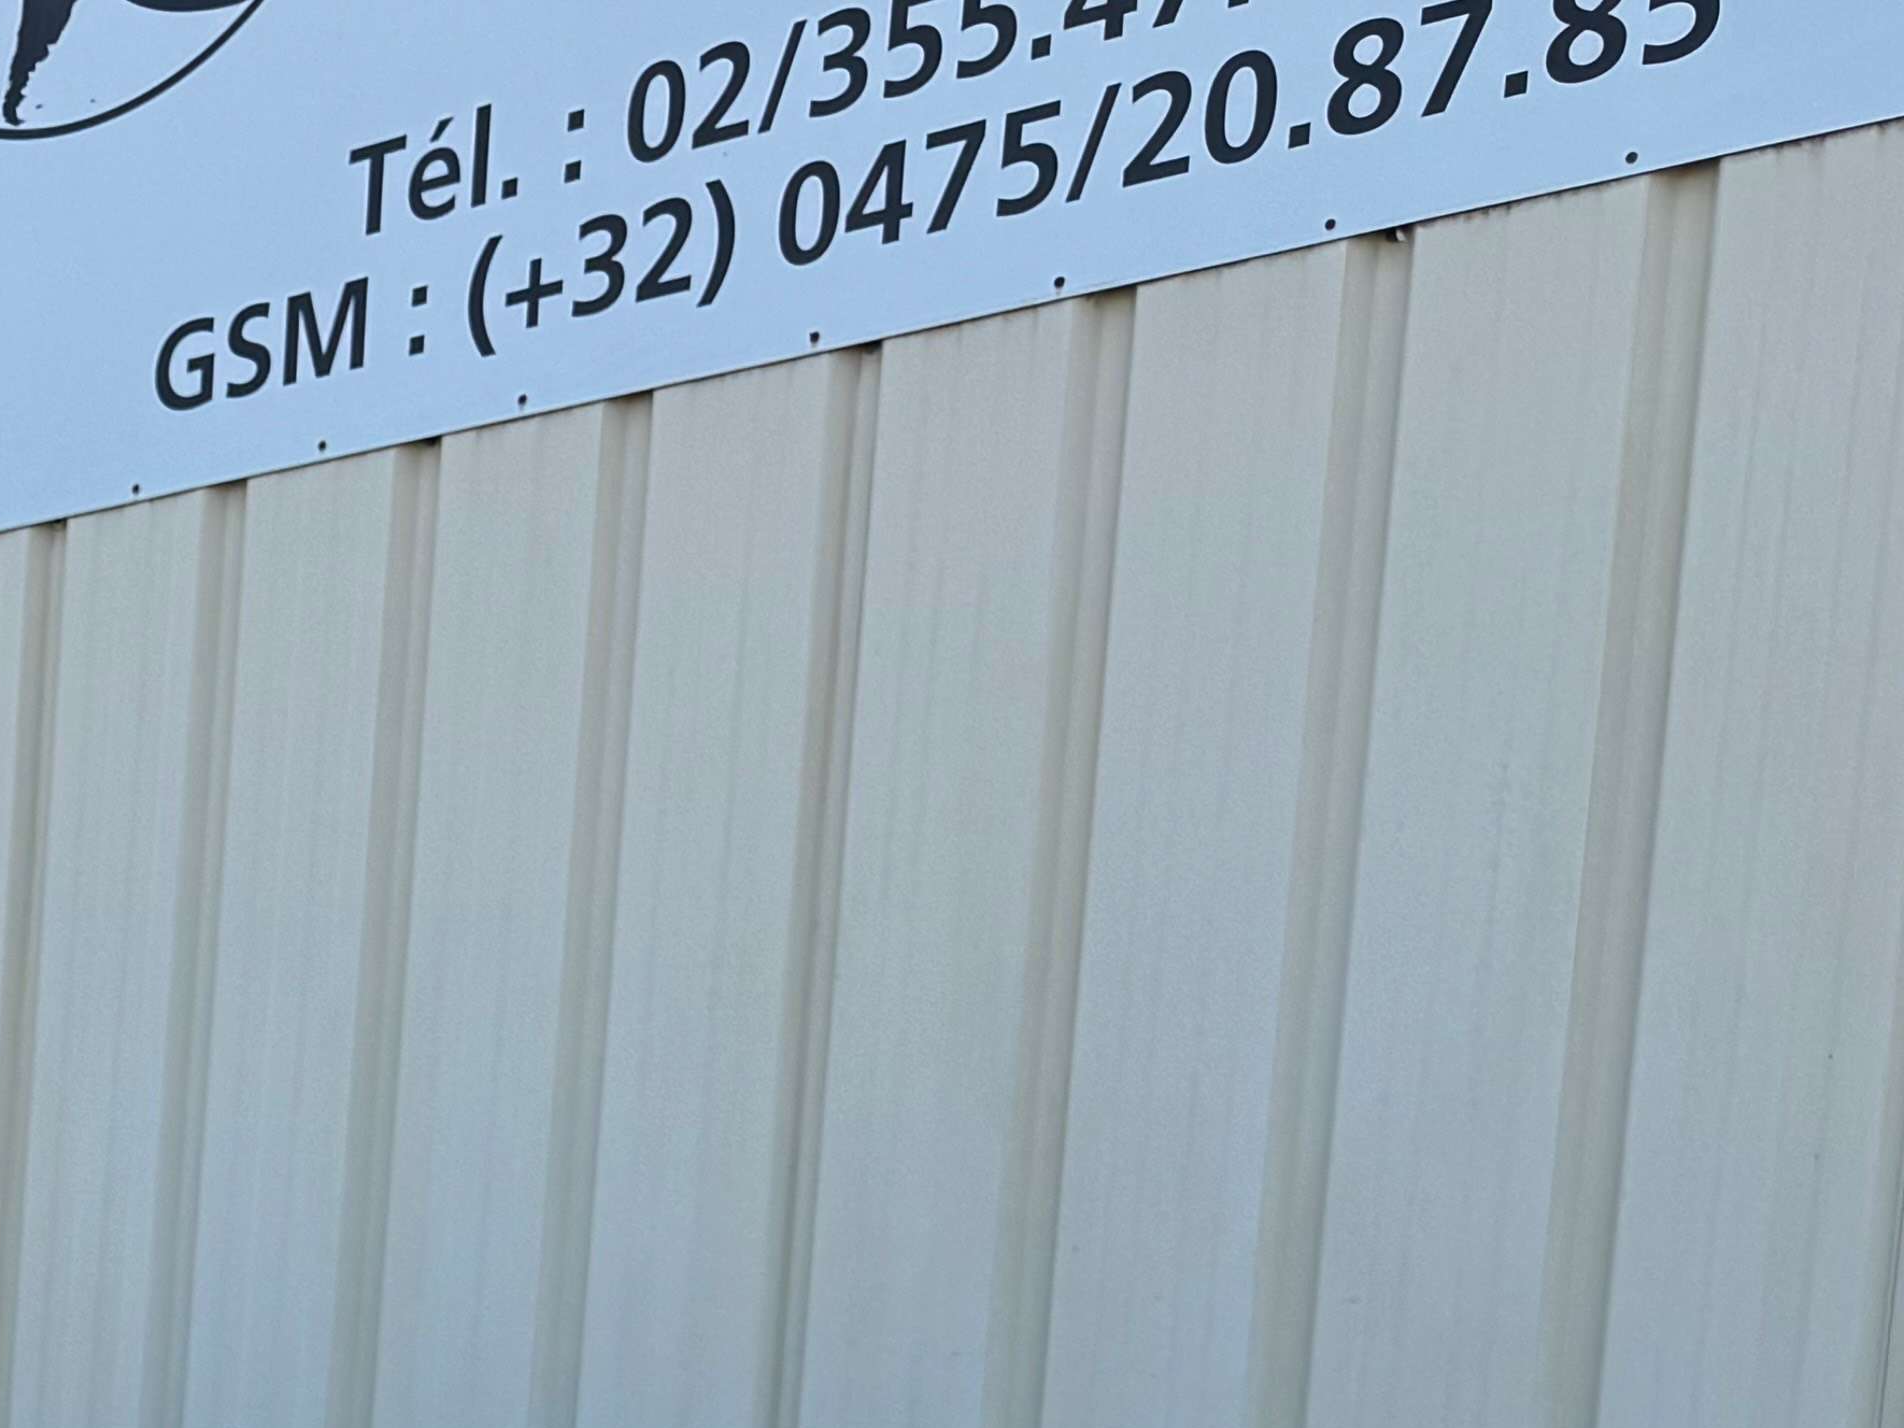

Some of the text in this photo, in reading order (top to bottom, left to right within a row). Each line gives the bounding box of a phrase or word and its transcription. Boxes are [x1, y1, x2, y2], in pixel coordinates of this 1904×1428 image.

[154, 0, 1721, 413] GSM : (+32) 0475/20.87.85
[349, 103, 518, 236] Tél.
[563, 107, 586, 184] :
